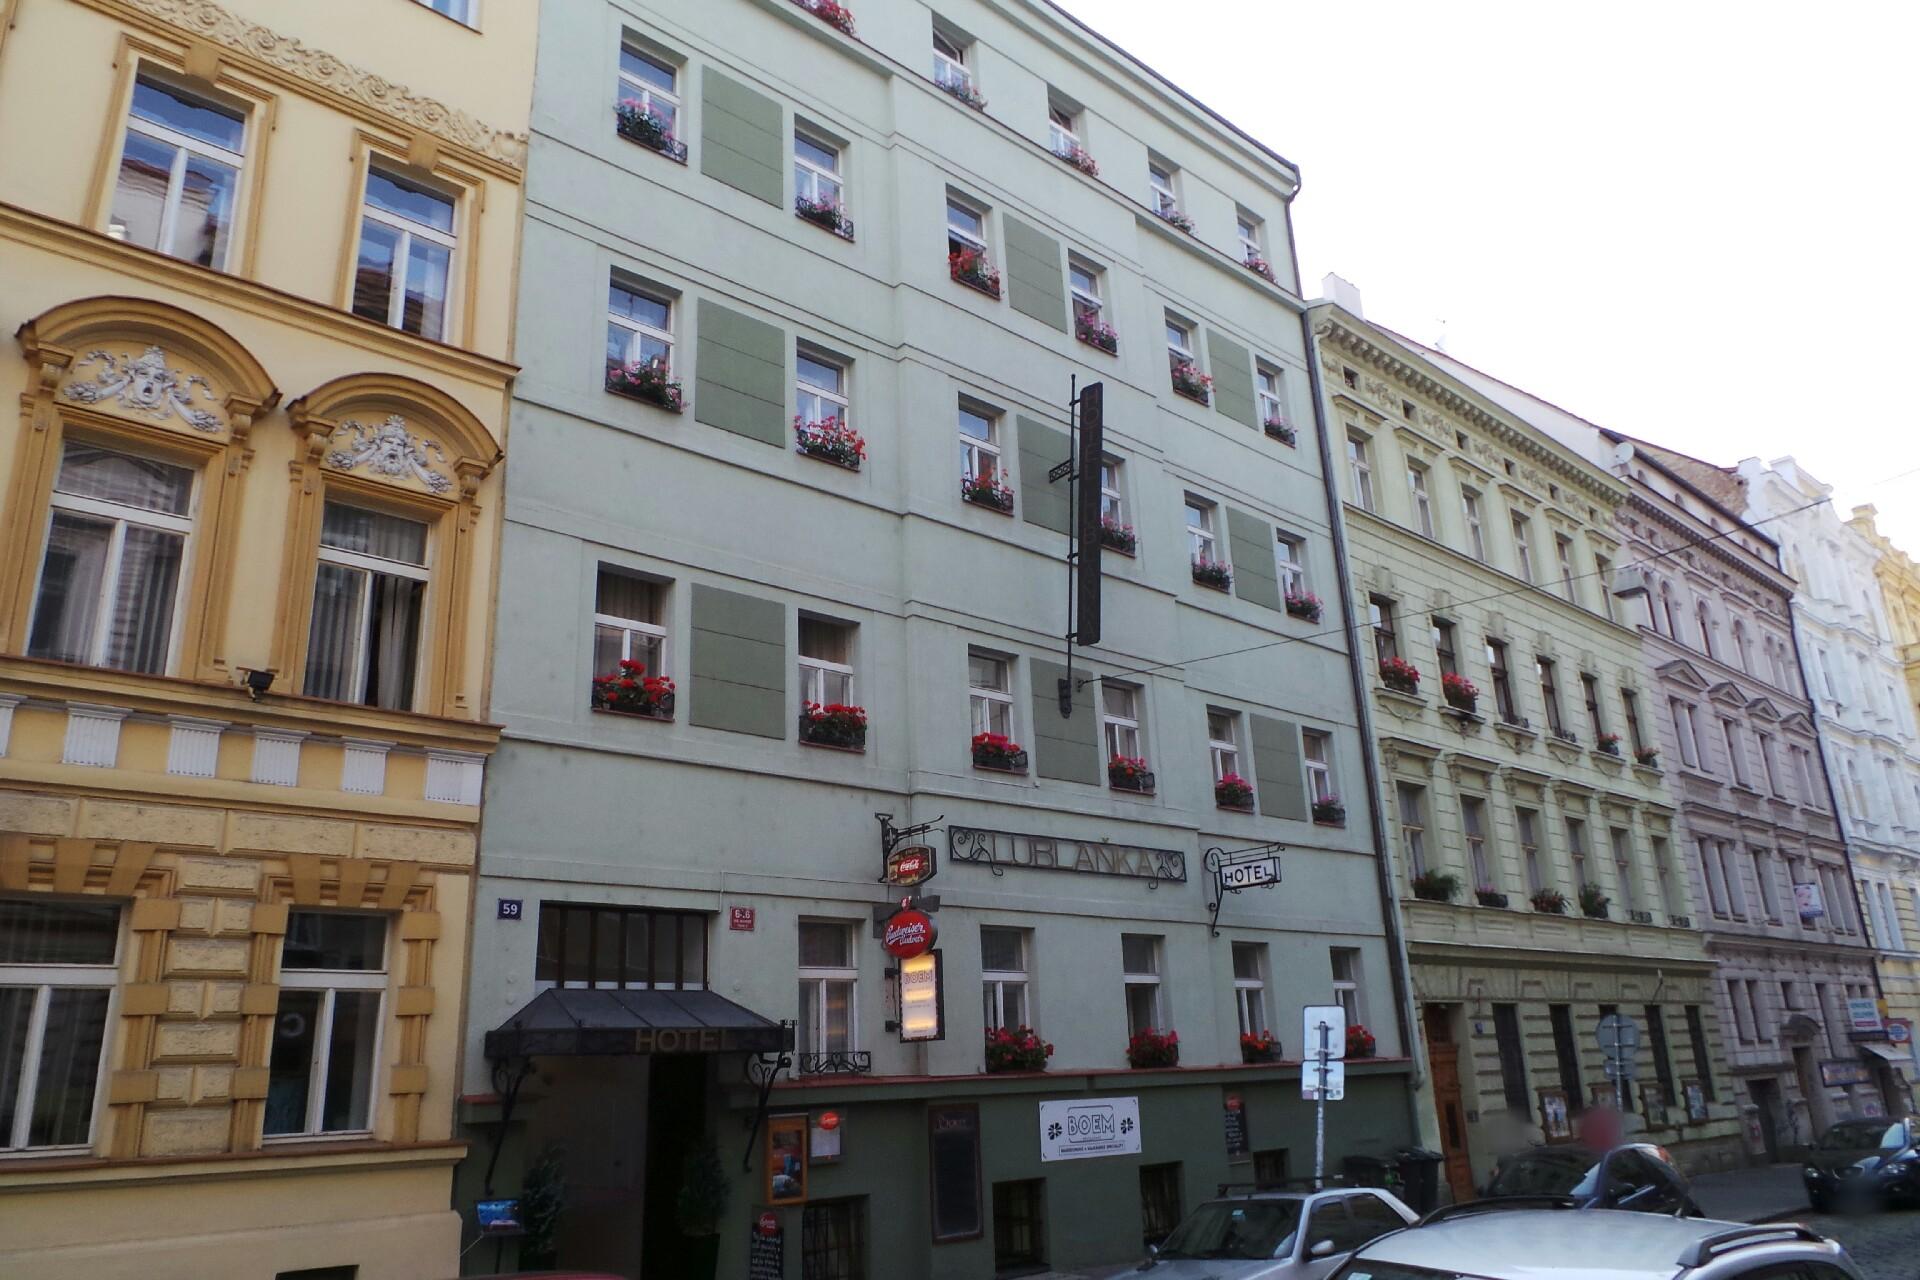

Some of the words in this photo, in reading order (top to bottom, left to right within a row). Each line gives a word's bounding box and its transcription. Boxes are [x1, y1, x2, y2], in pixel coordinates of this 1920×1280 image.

[1083, 388, 1099, 481] HOTEL
[1224, 865, 1273, 883] HOTEL
[503, 903, 518, 915] 59
[635, 1029, 737, 1052] HOTEL
[1067, 1113, 1115, 1136] BOEM
